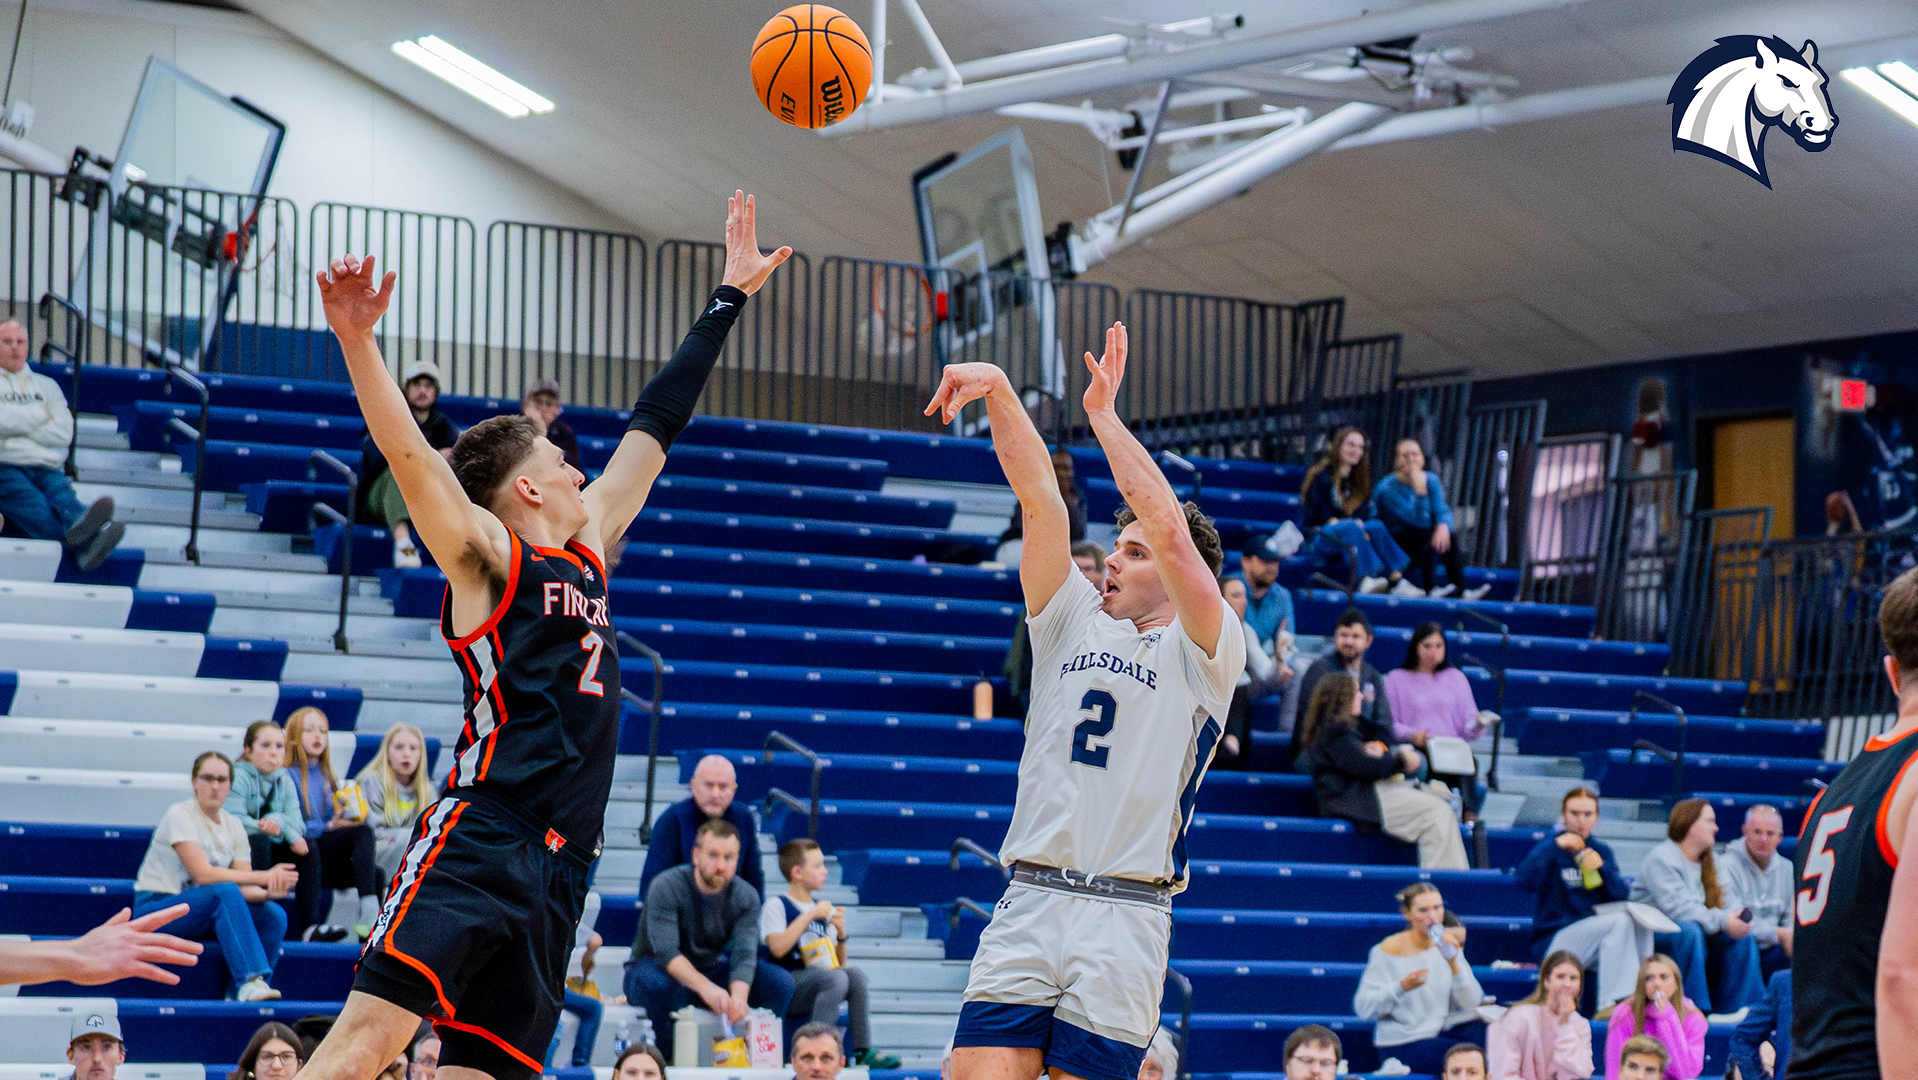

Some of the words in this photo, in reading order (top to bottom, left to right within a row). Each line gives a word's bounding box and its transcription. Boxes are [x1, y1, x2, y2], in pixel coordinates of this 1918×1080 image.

[781, 92, 797, 126] EV
[821, 75, 845, 127] Wils
[578, 630, 604, 697] 2
[1069, 686, 1119, 771] 2
[1796, 804, 1854, 927] 5
